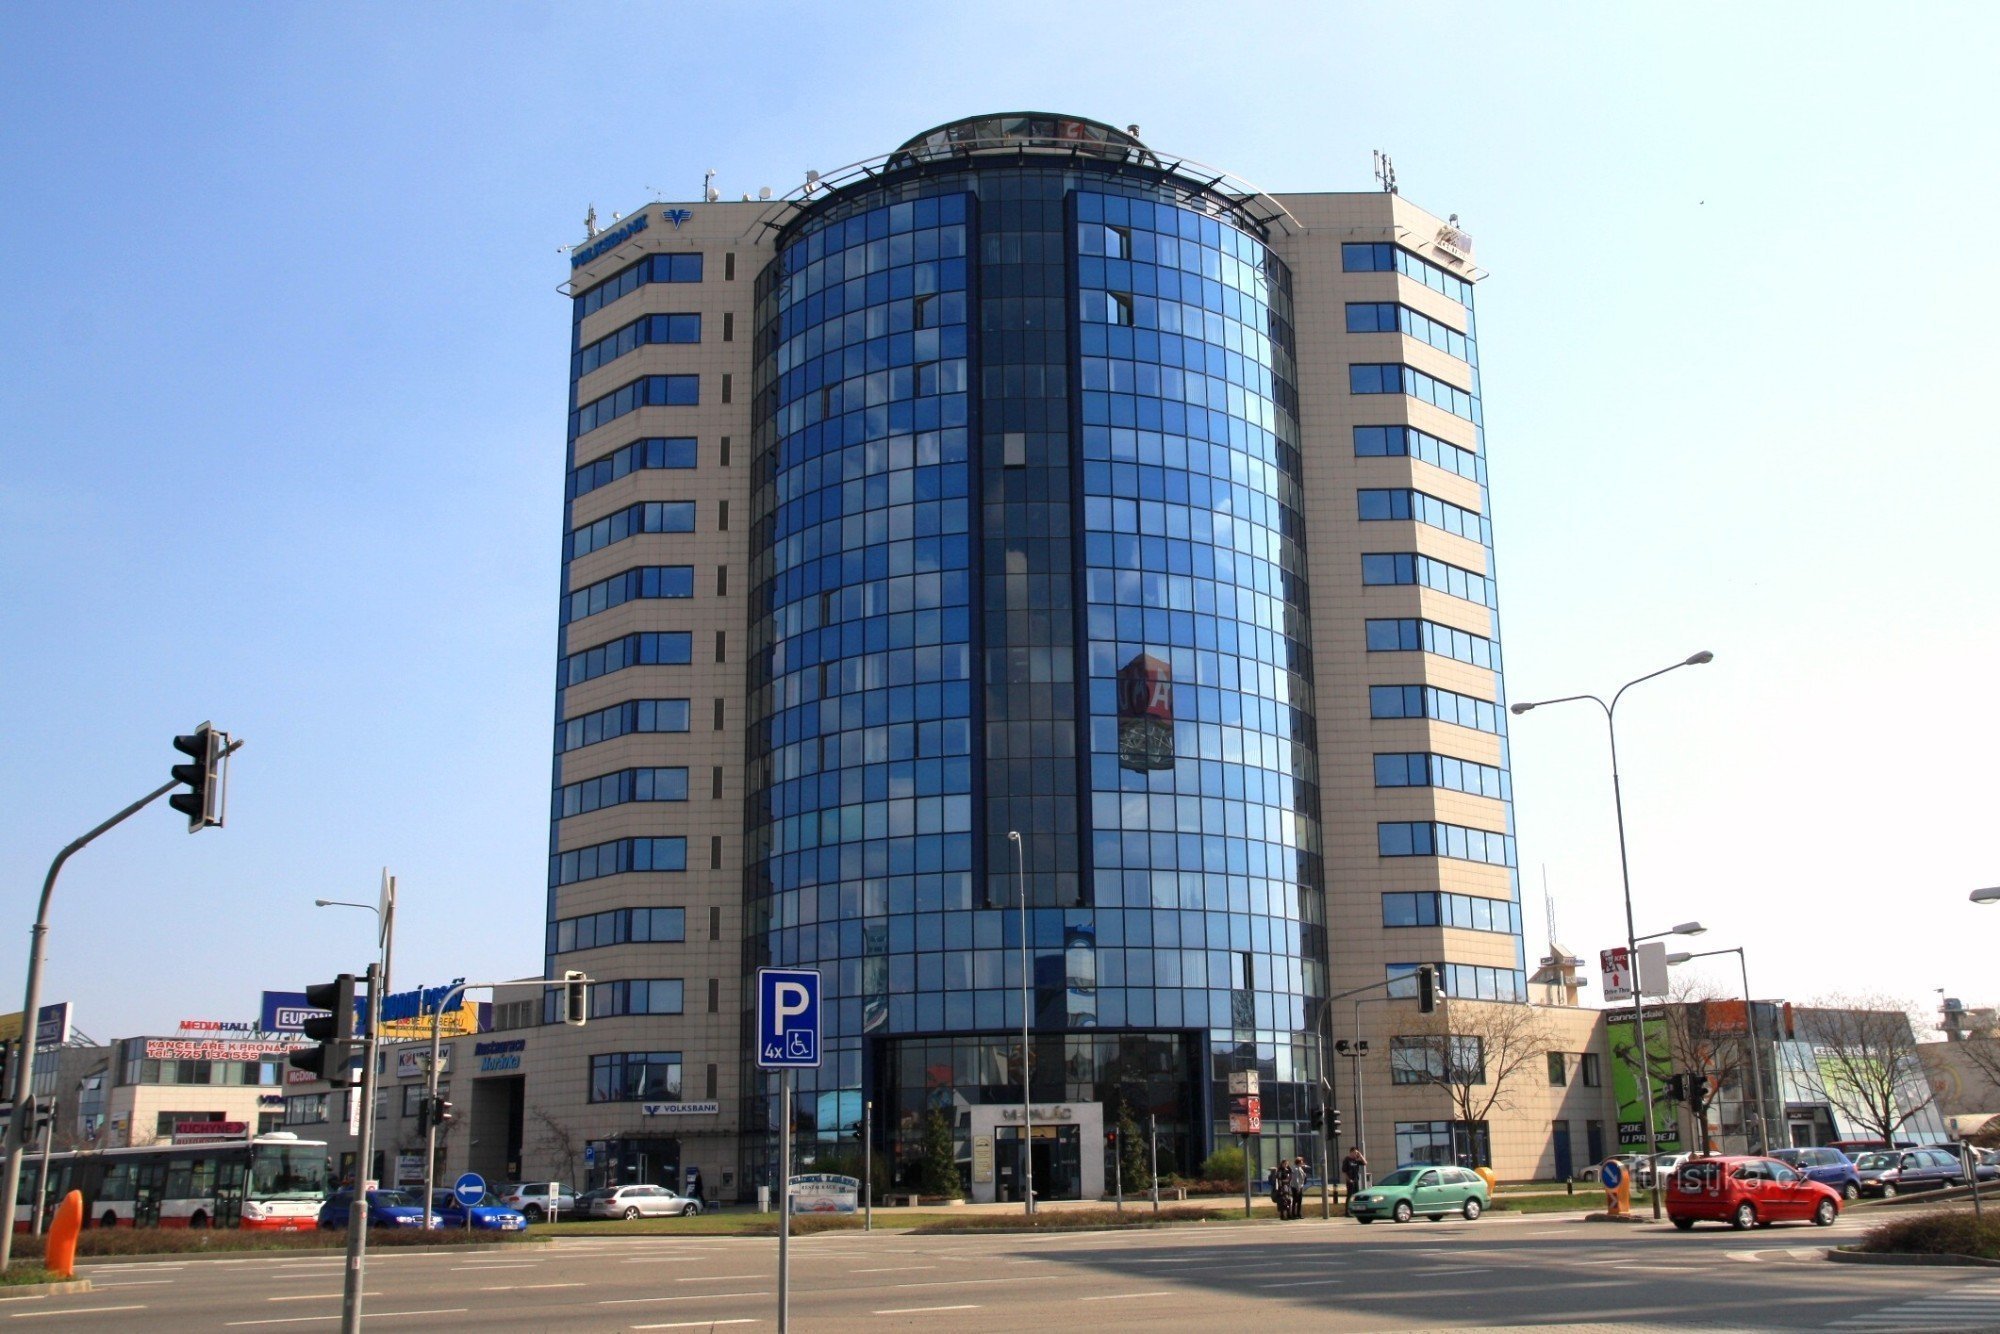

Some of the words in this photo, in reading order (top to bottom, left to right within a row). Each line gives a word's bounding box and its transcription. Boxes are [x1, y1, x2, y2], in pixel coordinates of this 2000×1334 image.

[774, 981, 810, 1036] P
[1608, 1011, 1664, 1022] cannodale
[174, 1050, 201, 1059] 775
[206, 1051, 231, 1060] 134
[232, 1052, 259, 1061] 555
[764, 1042, 783, 1059] 4x
[664, 1104, 717, 1112] VOLKSBANK
[1632, 1132, 1676, 1142] PRDEJI
